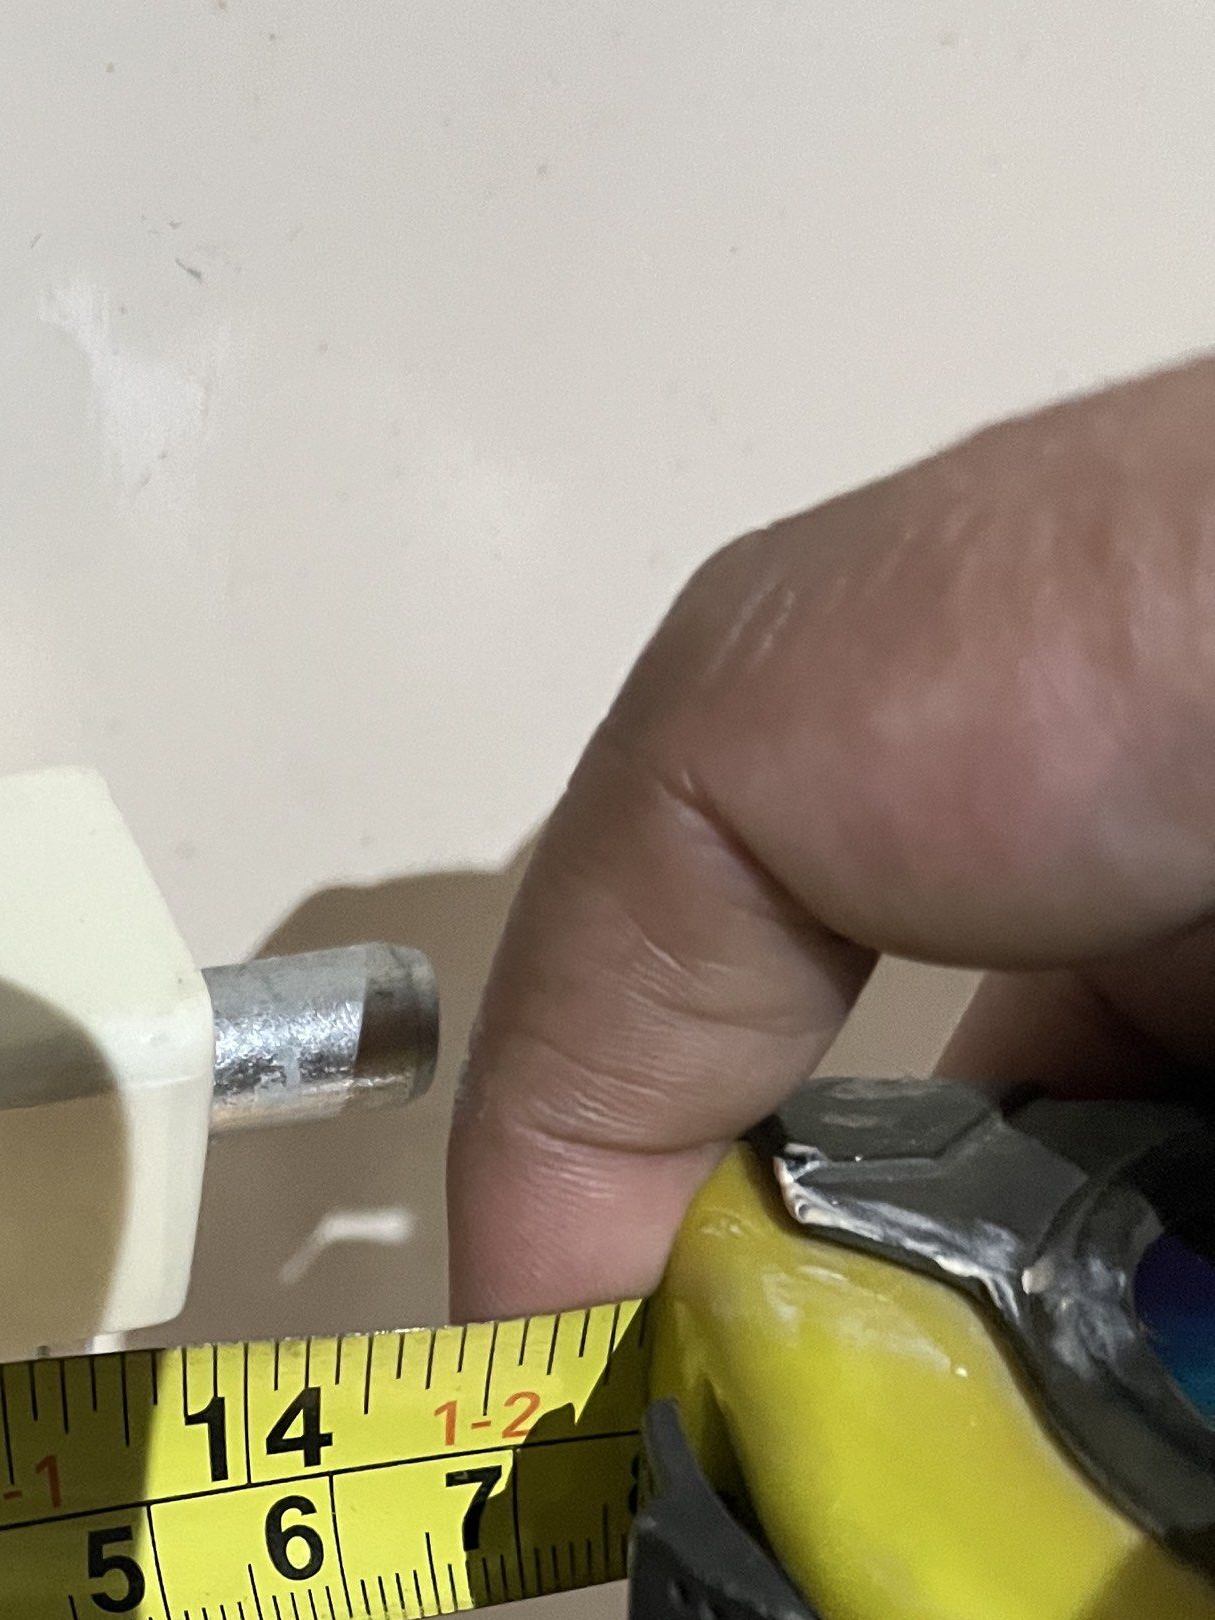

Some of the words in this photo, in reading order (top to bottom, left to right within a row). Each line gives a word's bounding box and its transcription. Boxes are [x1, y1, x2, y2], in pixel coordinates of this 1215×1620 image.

[184, 1386, 333, 1482] 14
[434, 1390, 542, 1447] 1-2
[264, 1495, 324, 1581] 6
[445, 1464, 503, 1551] 7
[87, 1525, 146, 1614] 5
